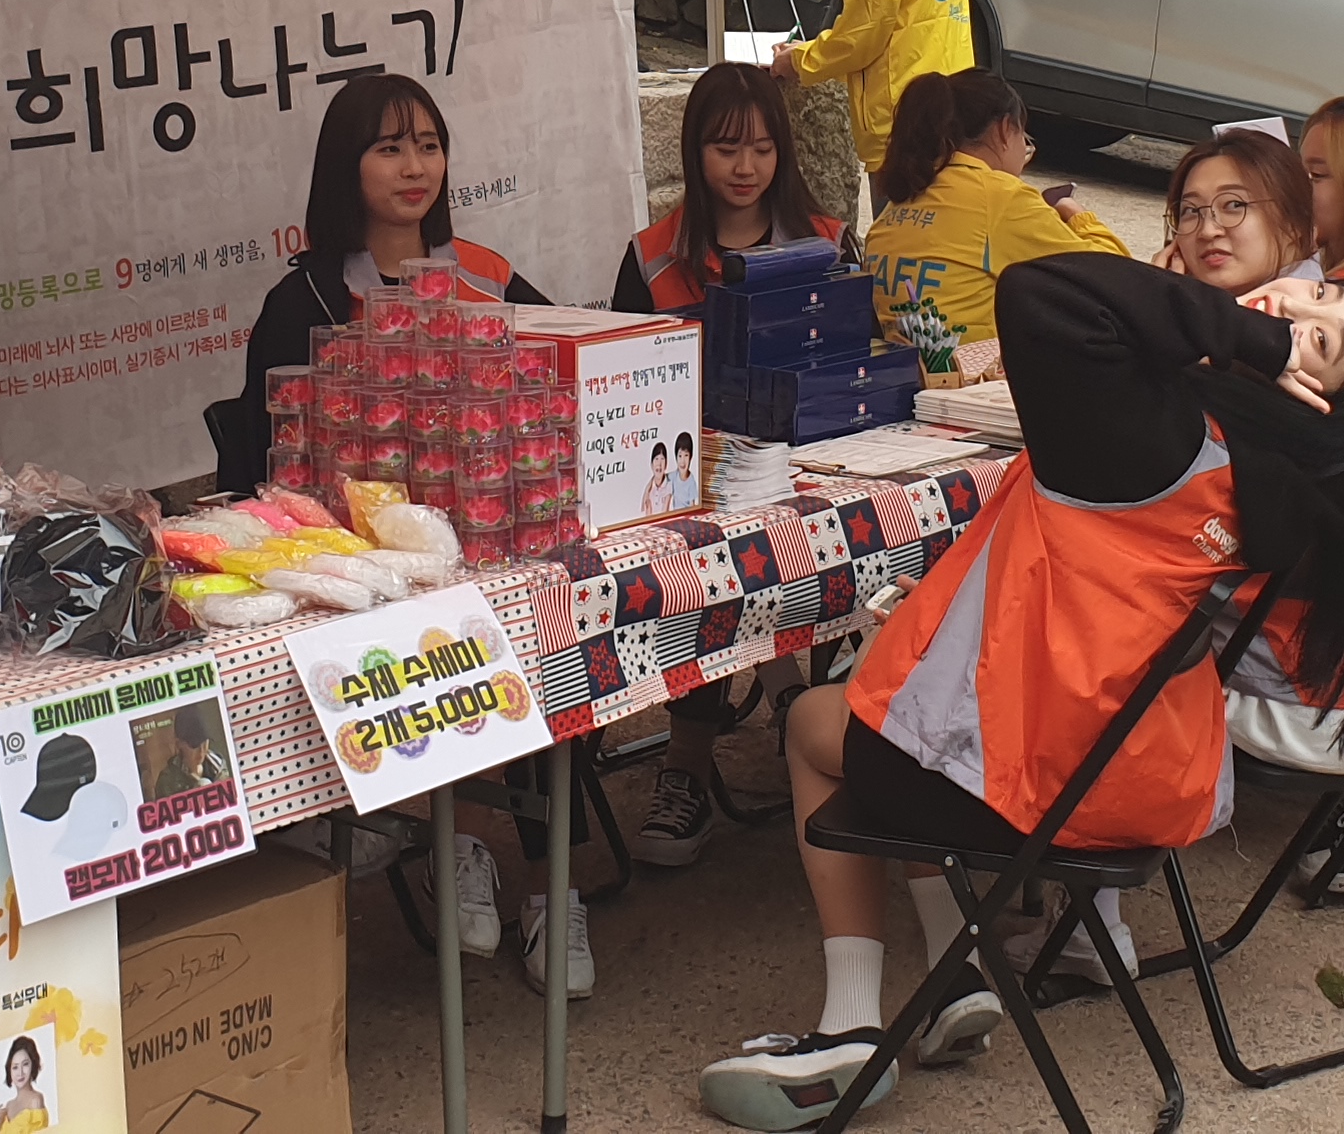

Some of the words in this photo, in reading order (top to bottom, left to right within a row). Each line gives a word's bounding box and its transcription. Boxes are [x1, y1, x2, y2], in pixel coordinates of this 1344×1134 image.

[193, 249, 208, 271] 새
[46, 334, 76, 357] 뇌사
[79, 330, 107, 351] 또는
[111, 320, 153, 344] 사망에
[213, 303, 228, 322] 때
[125, 343, 181, 374] 실기증시
[586, 407, 625, 427] 오늘보다
[630, 404, 640, 416] 더
[341, 663, 401, 708] 수제
[403, 636, 486, 688] 수세미
[33, 689, 114, 734] 삼시세끼
[115, 673, 175, 711] 윤세아
[177, 663, 216, 694] 모자
[356, 707, 411, 753] 2개
[409, 679, 499, 734] 5,000
[137, 780, 238, 834] CAPTEN
[65, 851, 141, 901] 캡모자
[142, 815, 244, 876] 20,000
[1, 982, 49, 1011] 특설무대
[220, 994, 273, 1035] MADE
[128, 1027, 188, 1070] CHINA
[192, 1016, 211, 1046] IN
